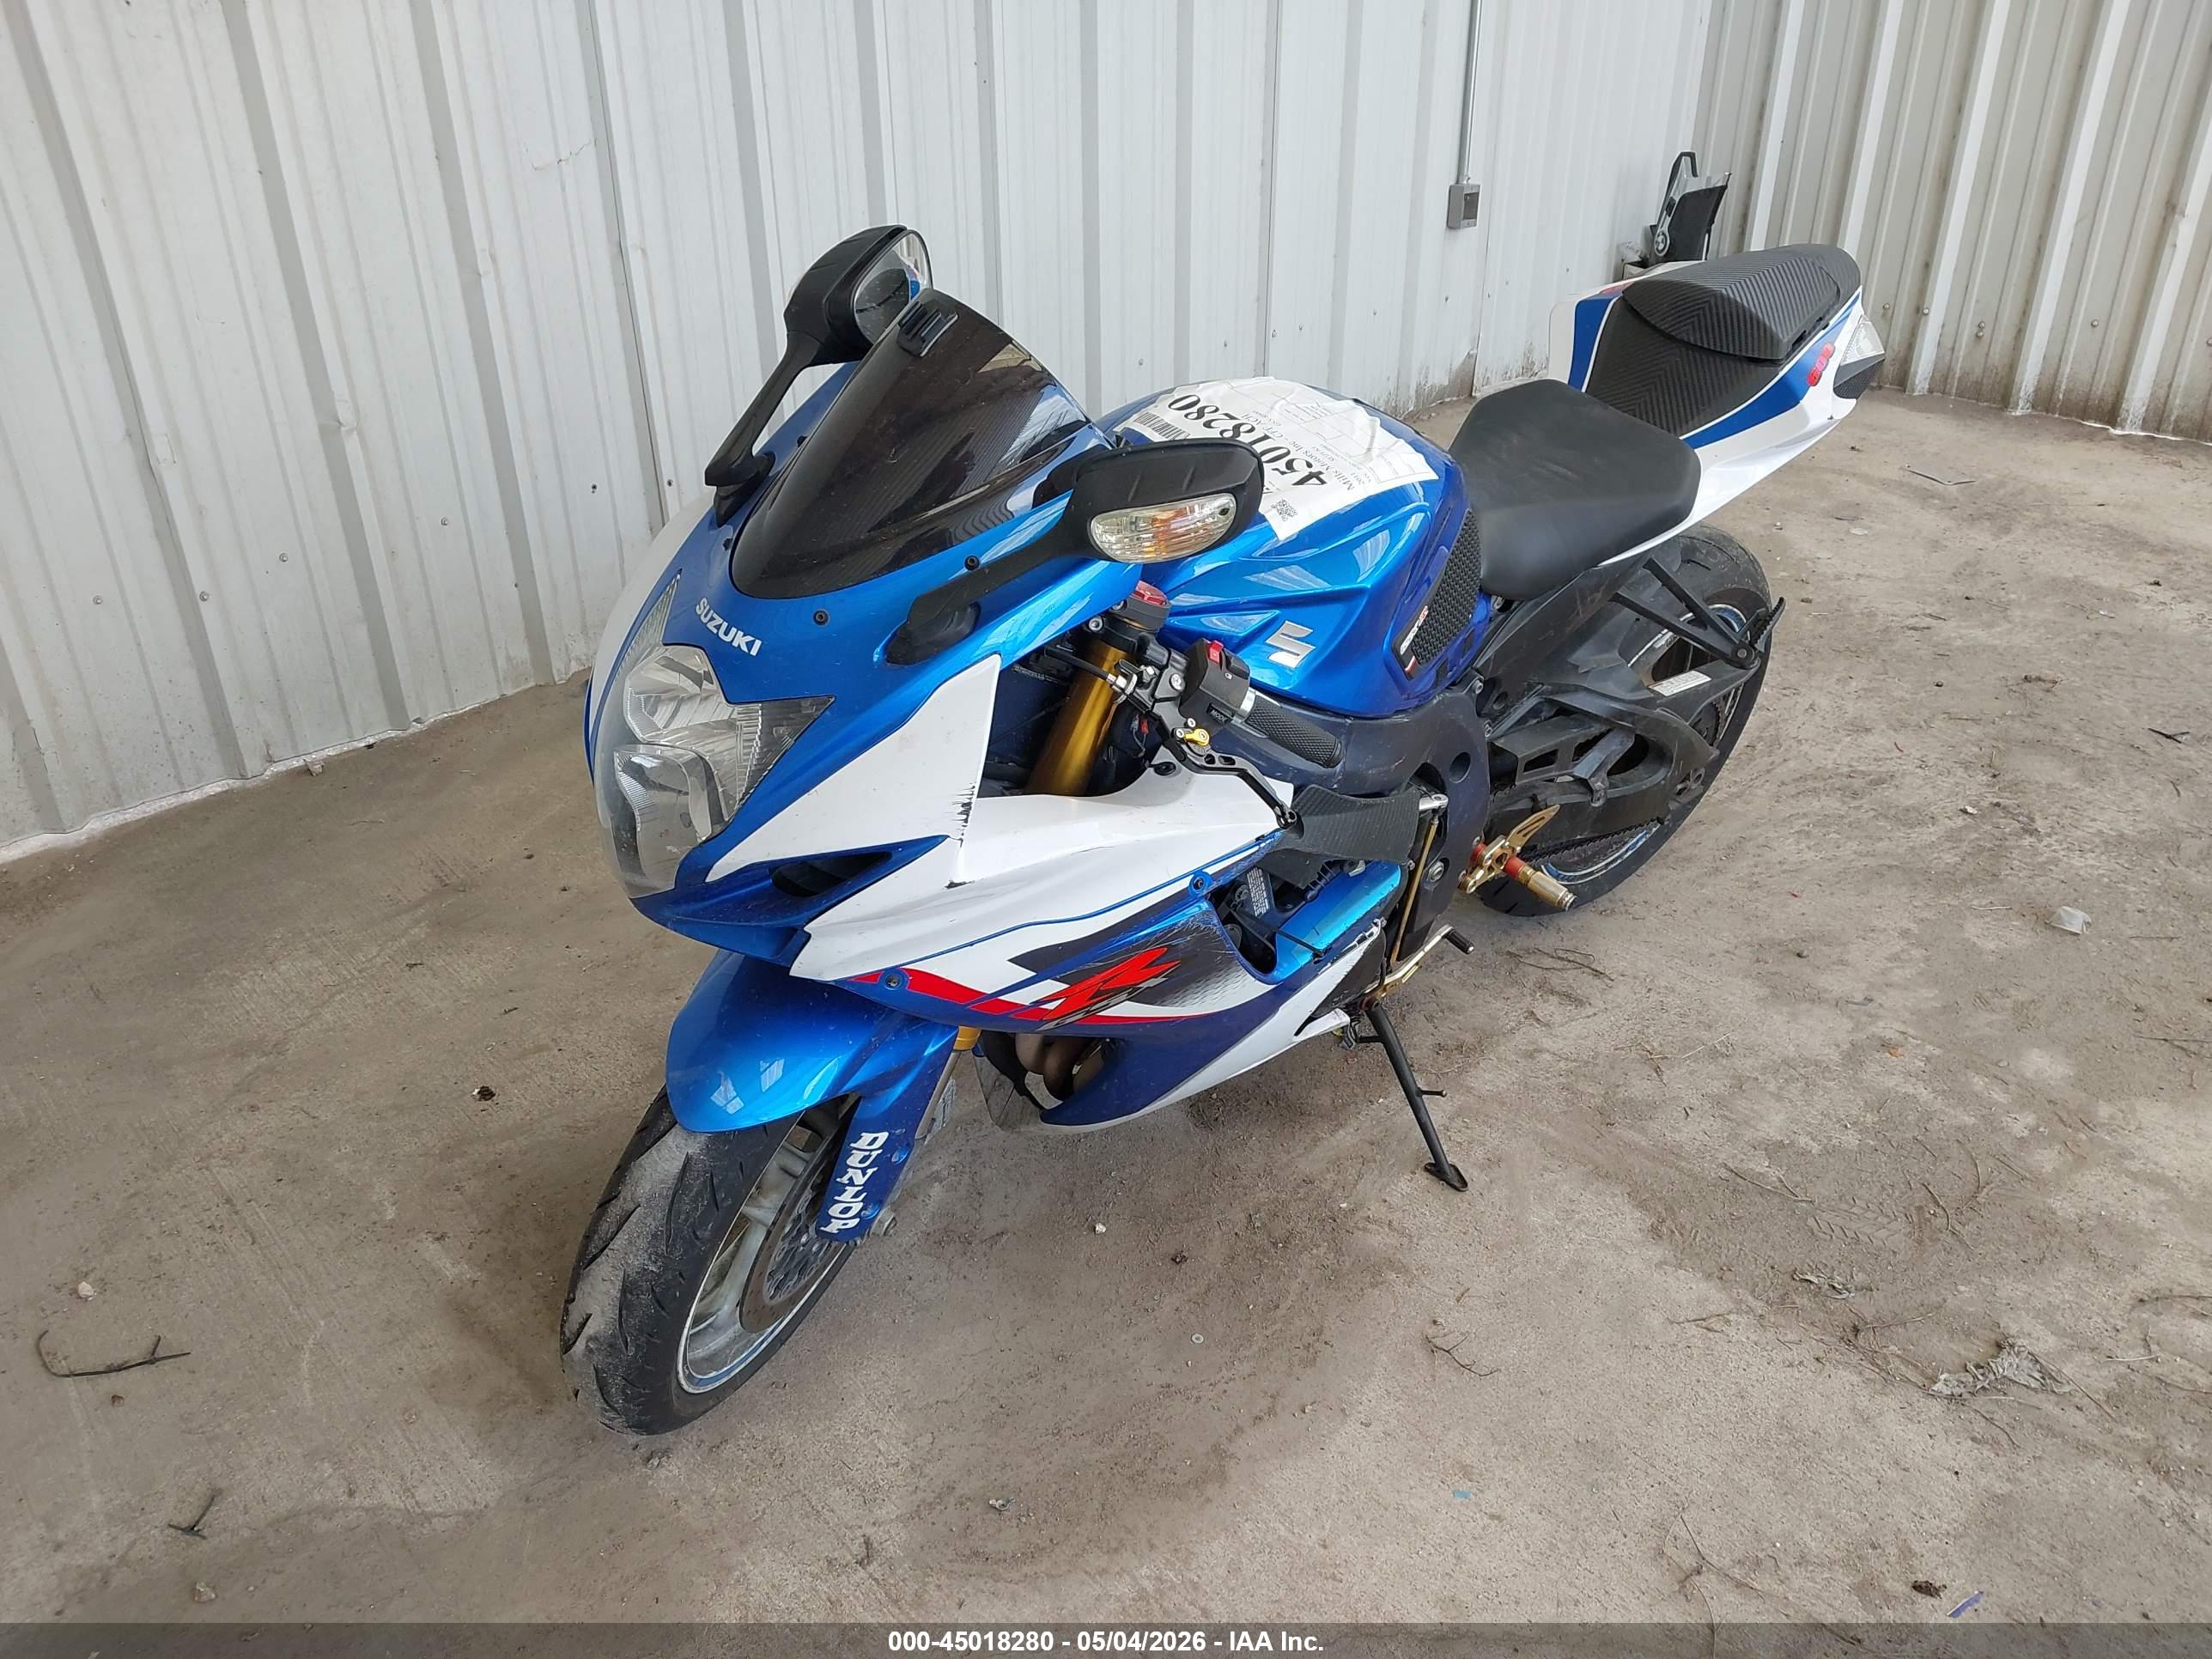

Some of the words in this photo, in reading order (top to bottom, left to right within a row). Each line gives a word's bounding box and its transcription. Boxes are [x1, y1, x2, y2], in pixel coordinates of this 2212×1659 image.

[1168, 394, 1328, 486] 45018280
[1303, 449, 1332, 471] Motors
[1333, 470, 1355, 490] Mills
[696, 598, 763, 657] SUZUKI
[1211, 709, 1228, 723] MODE
[820, 1131, 889, 1234] DUNLOP
